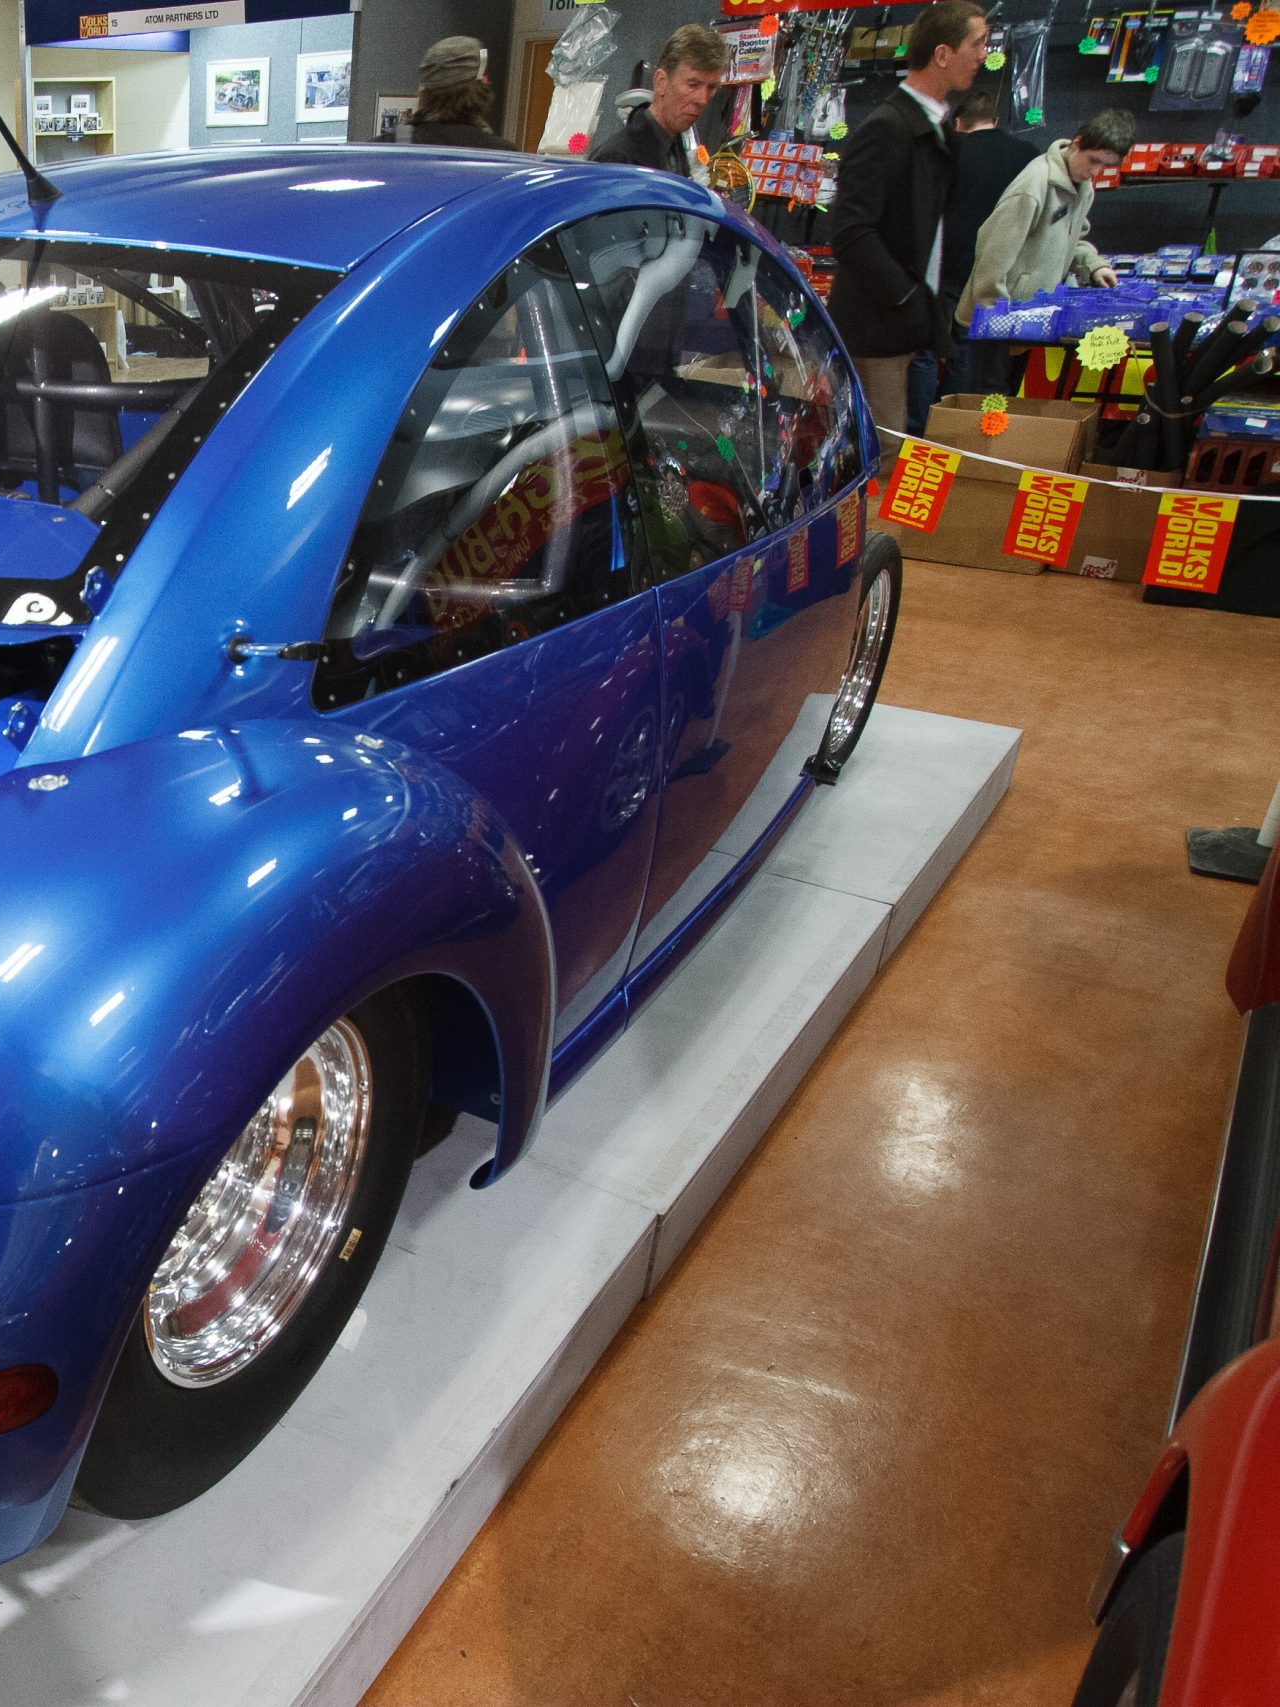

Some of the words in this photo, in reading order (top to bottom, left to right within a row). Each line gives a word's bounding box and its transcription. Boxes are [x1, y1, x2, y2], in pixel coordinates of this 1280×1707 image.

[80, 15, 109, 28] VOLKS
[80, 26, 109, 38] WORLD
[111, 19, 118, 28] 15
[144, 15, 164, 24] ATOM
[166, 11, 203, 22] PARTNERS
[205, 10, 219, 19] LTD
[739, 38, 770, 47] Booster
[739, 46, 766, 55] Cables
[891, 445, 931, 514] WORLD
[909, 453, 950, 521] VOLKS
[1016, 476, 1053, 549] WORLD
[1037, 483, 1076, 554] VOLKS
[1158, 497, 1198, 576] WORLD
[1183, 501, 1224, 580] VOLKS
